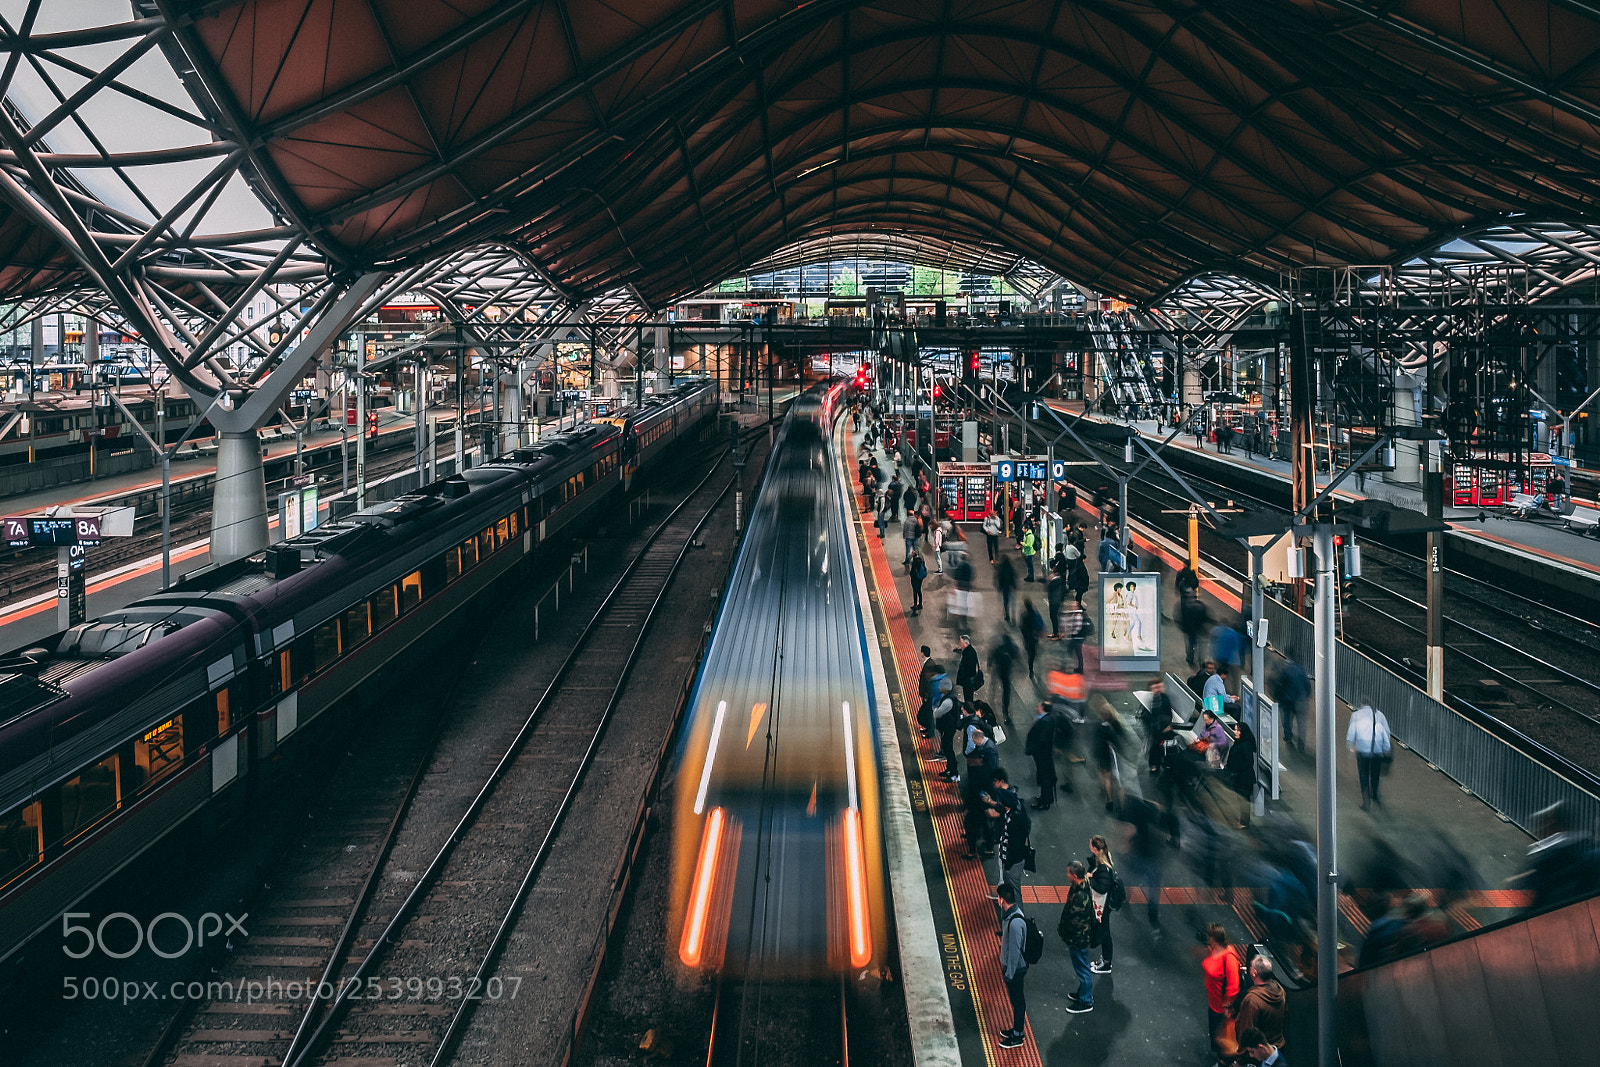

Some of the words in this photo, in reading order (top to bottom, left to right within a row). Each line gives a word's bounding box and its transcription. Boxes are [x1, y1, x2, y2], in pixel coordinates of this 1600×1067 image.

[1001, 463, 1012, 478] 9
[1052, 463, 1064, 478] 0
[7, 521, 25, 536] 7A
[78, 520, 99, 535] 8A
[941, 933, 957, 953] MIND
[946, 954, 962, 971] THE
[949, 971, 966, 991] GAP
